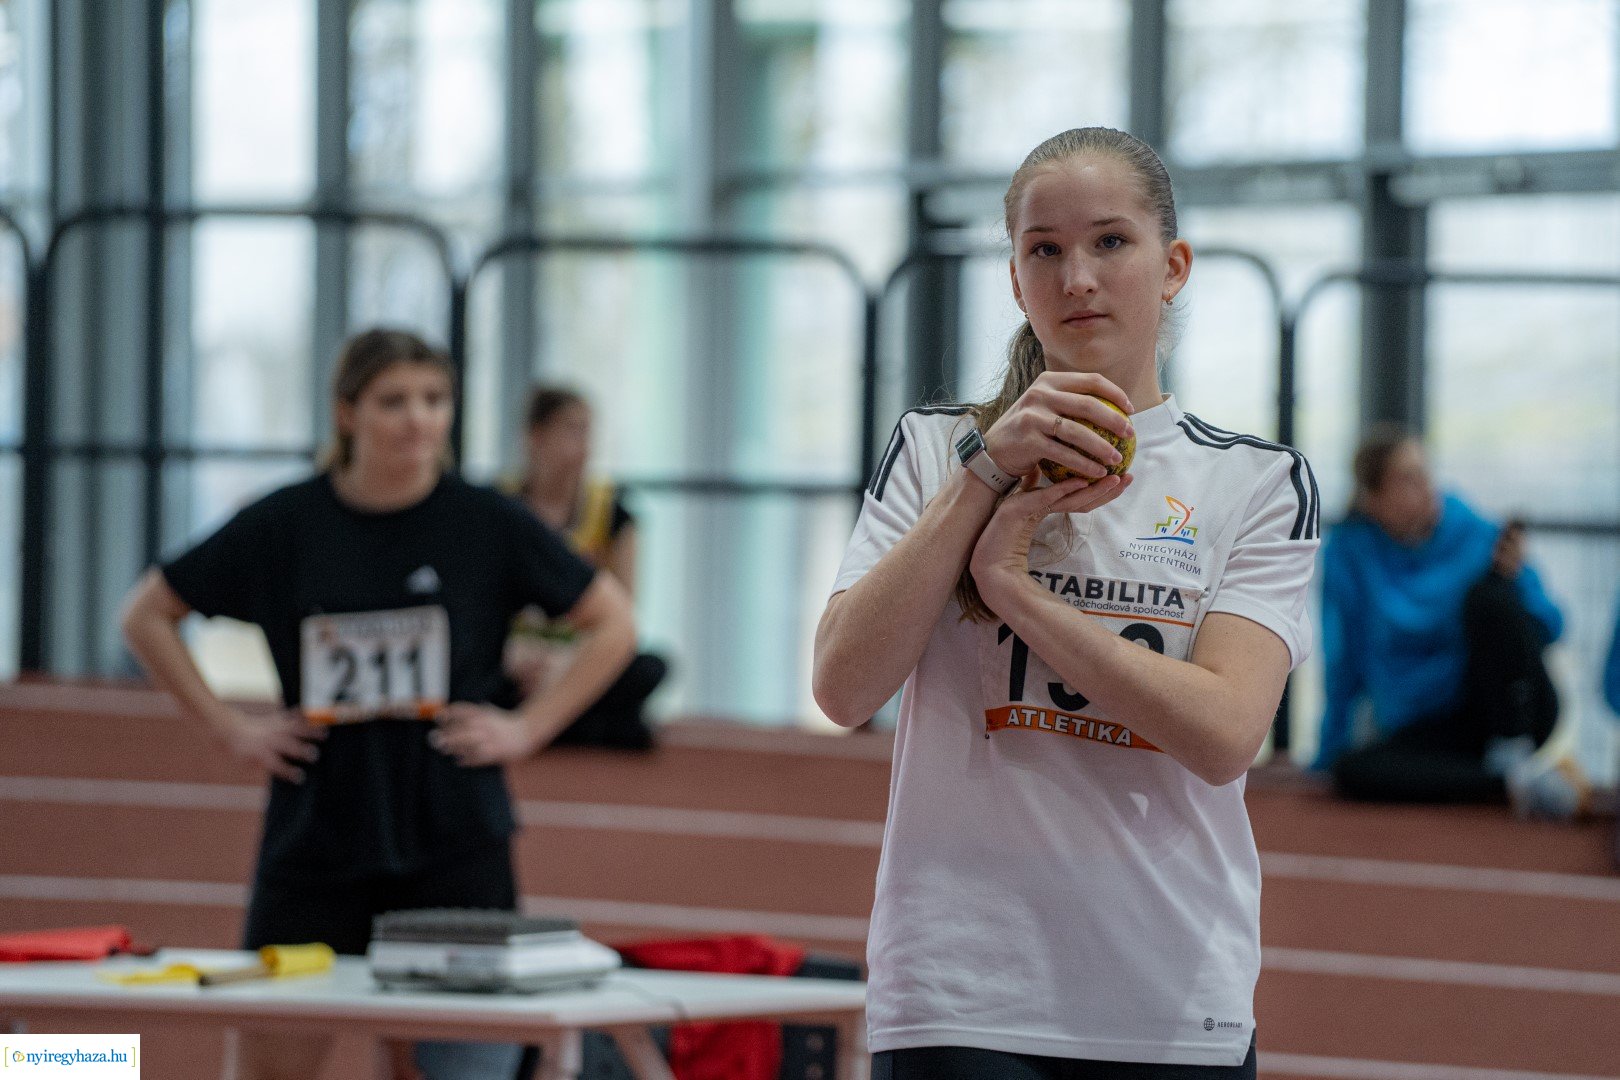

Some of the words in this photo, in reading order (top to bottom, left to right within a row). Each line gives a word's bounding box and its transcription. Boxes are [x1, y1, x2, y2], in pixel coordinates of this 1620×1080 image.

[1119, 551, 1201, 575] SPORTCENTRUM
[1129, 543, 1197, 561] NYÍREGYHÁZI
[328, 645, 423, 700] 211
[1006, 708, 1132, 747] ATLETIKA
